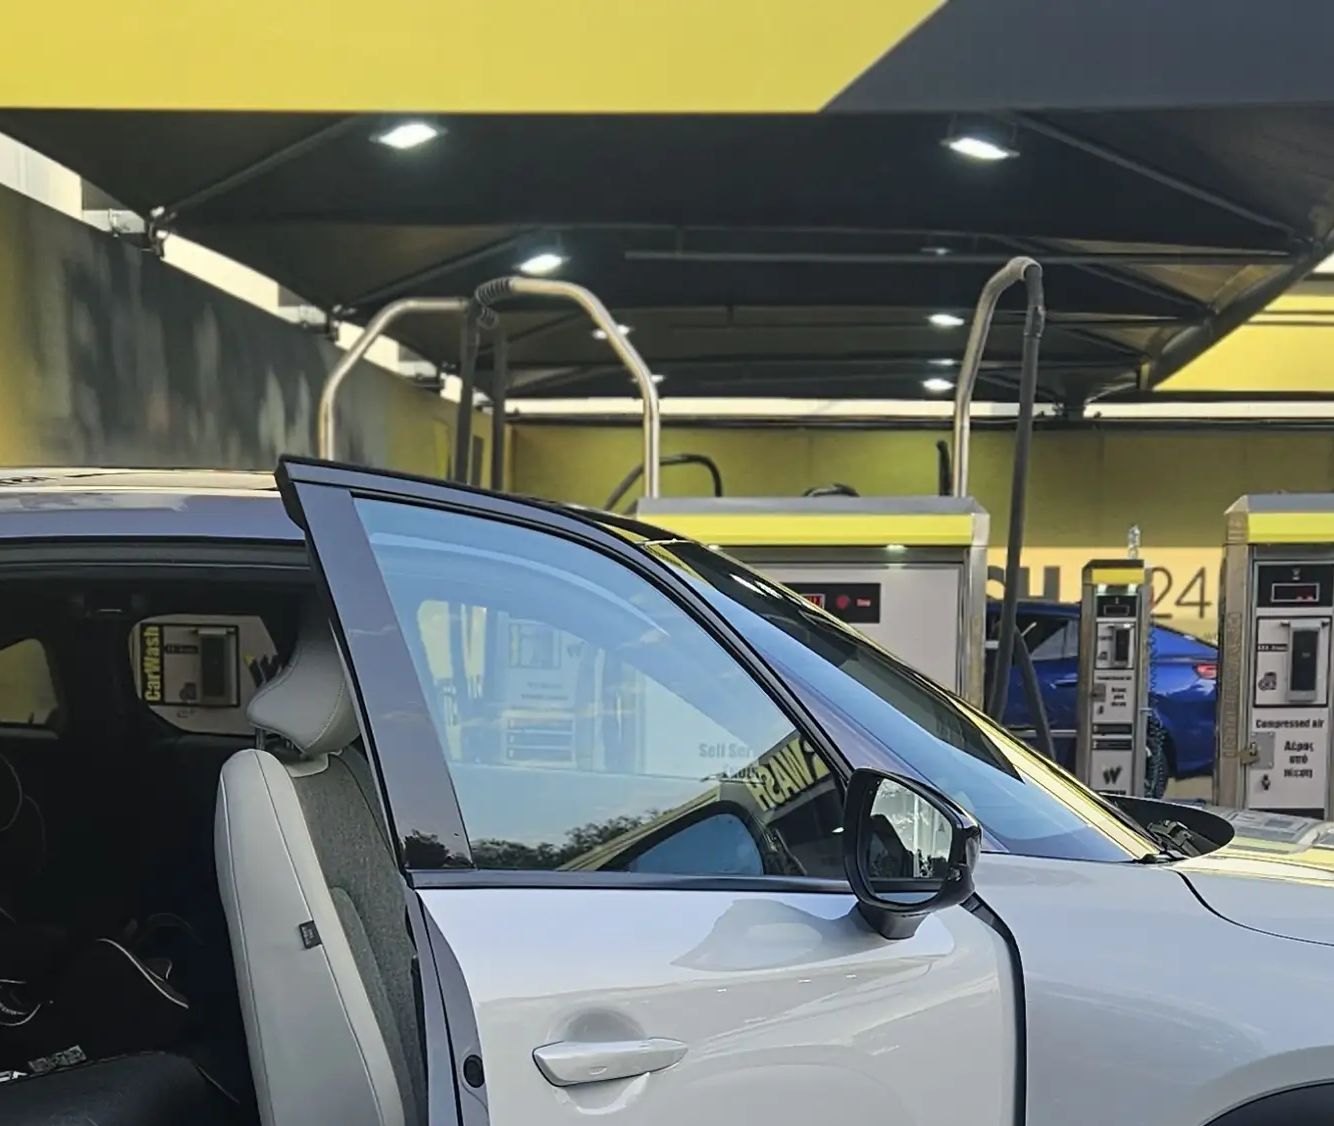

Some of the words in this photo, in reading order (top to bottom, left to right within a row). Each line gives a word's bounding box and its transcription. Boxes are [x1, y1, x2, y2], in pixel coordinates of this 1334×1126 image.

[1152, 566, 1213, 619] 24
[144, 626, 162, 702] CarWash
[1255, 718, 1310, 729] Compressed
[1312, 718, 1325, 728] air
